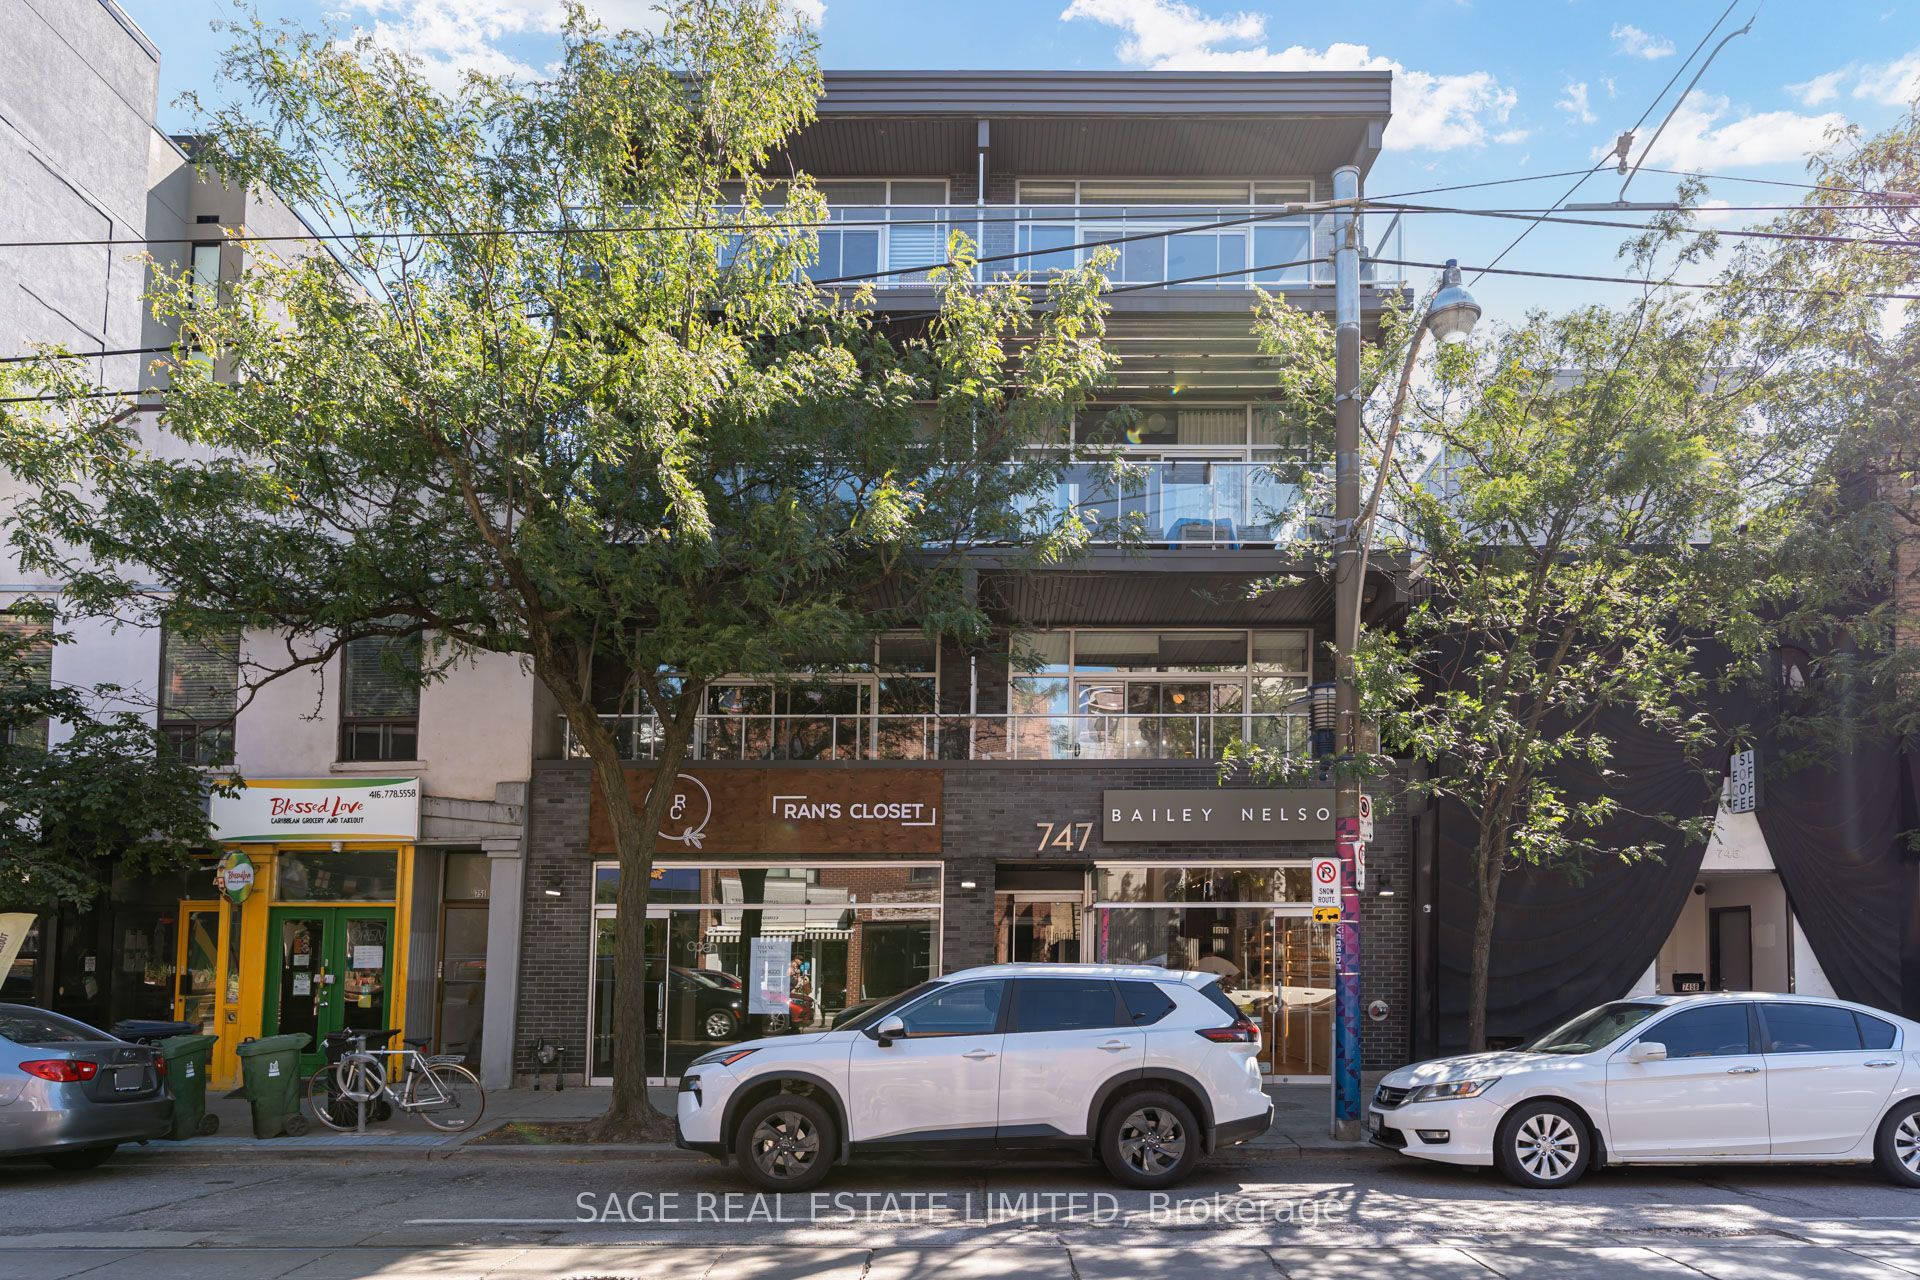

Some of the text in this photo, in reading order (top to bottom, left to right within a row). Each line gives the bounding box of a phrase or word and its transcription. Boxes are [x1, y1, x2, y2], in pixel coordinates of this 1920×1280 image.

[369, 789, 416, 799] 416.778.5558
[270, 796, 364, 817] Blessed Love
[784, 803, 924, 819] RAN'S CLOSET
[1111, 807, 1331, 823] BAILEY NELSO
[1036, 822, 1094, 852] 747
[686, 940, 718, 960] open
